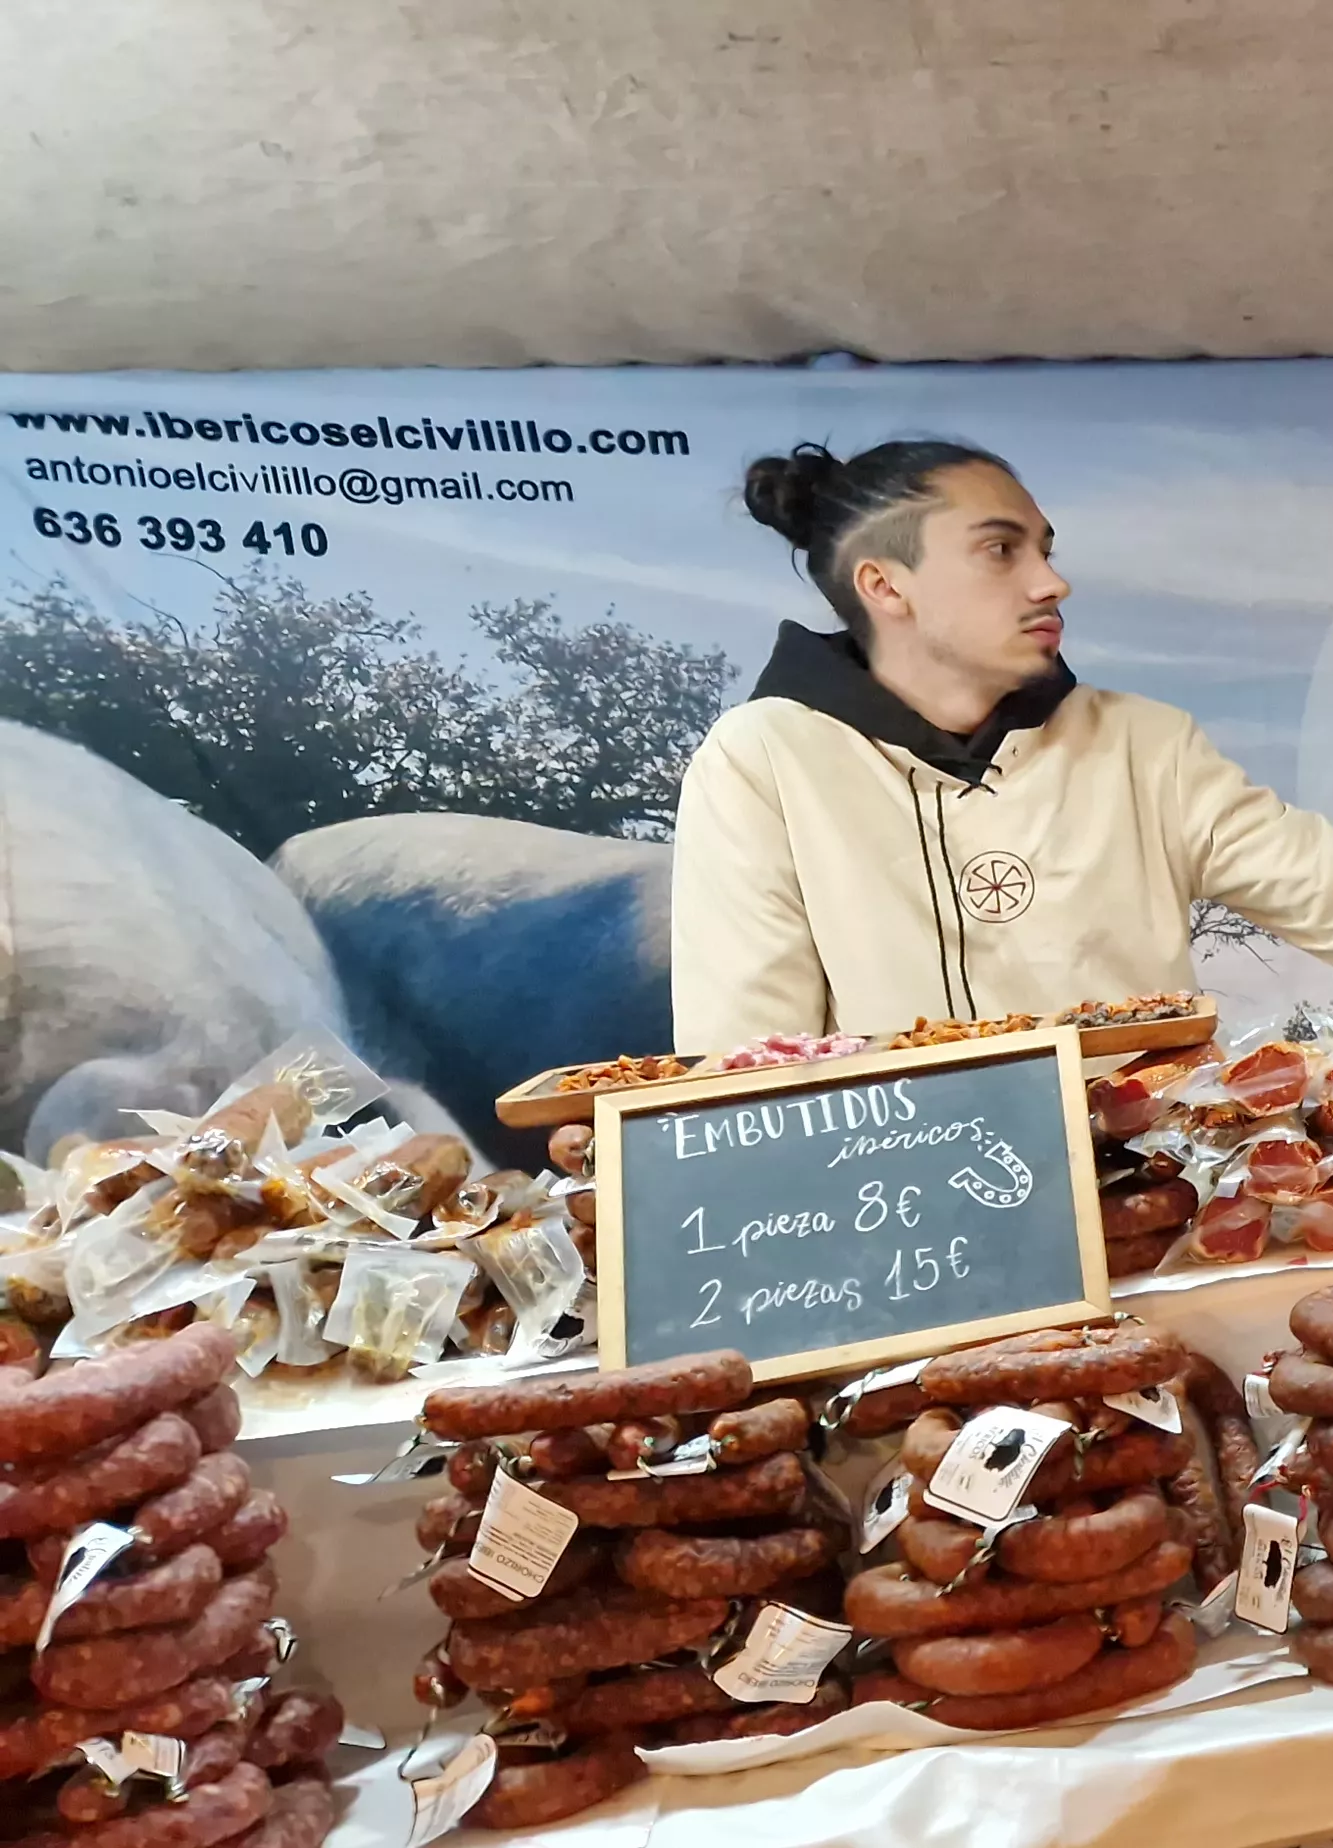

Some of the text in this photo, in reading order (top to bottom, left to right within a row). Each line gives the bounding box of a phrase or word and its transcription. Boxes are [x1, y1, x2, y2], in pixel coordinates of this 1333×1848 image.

[8, 411, 690, 456] www.ibericoselcivilillo.com
[25, 456, 575, 505] antonioelcivilillo@gmail.com
[33, 507, 328, 557] 636 393 410
[673, 1077, 917, 1161] EMBUTIDOS
[680, 1206, 726, 1257] 1
[732, 1206, 836, 1258] pieza
[689, 1279, 723, 1330] 2
[740, 1277, 864, 1326] piezas
